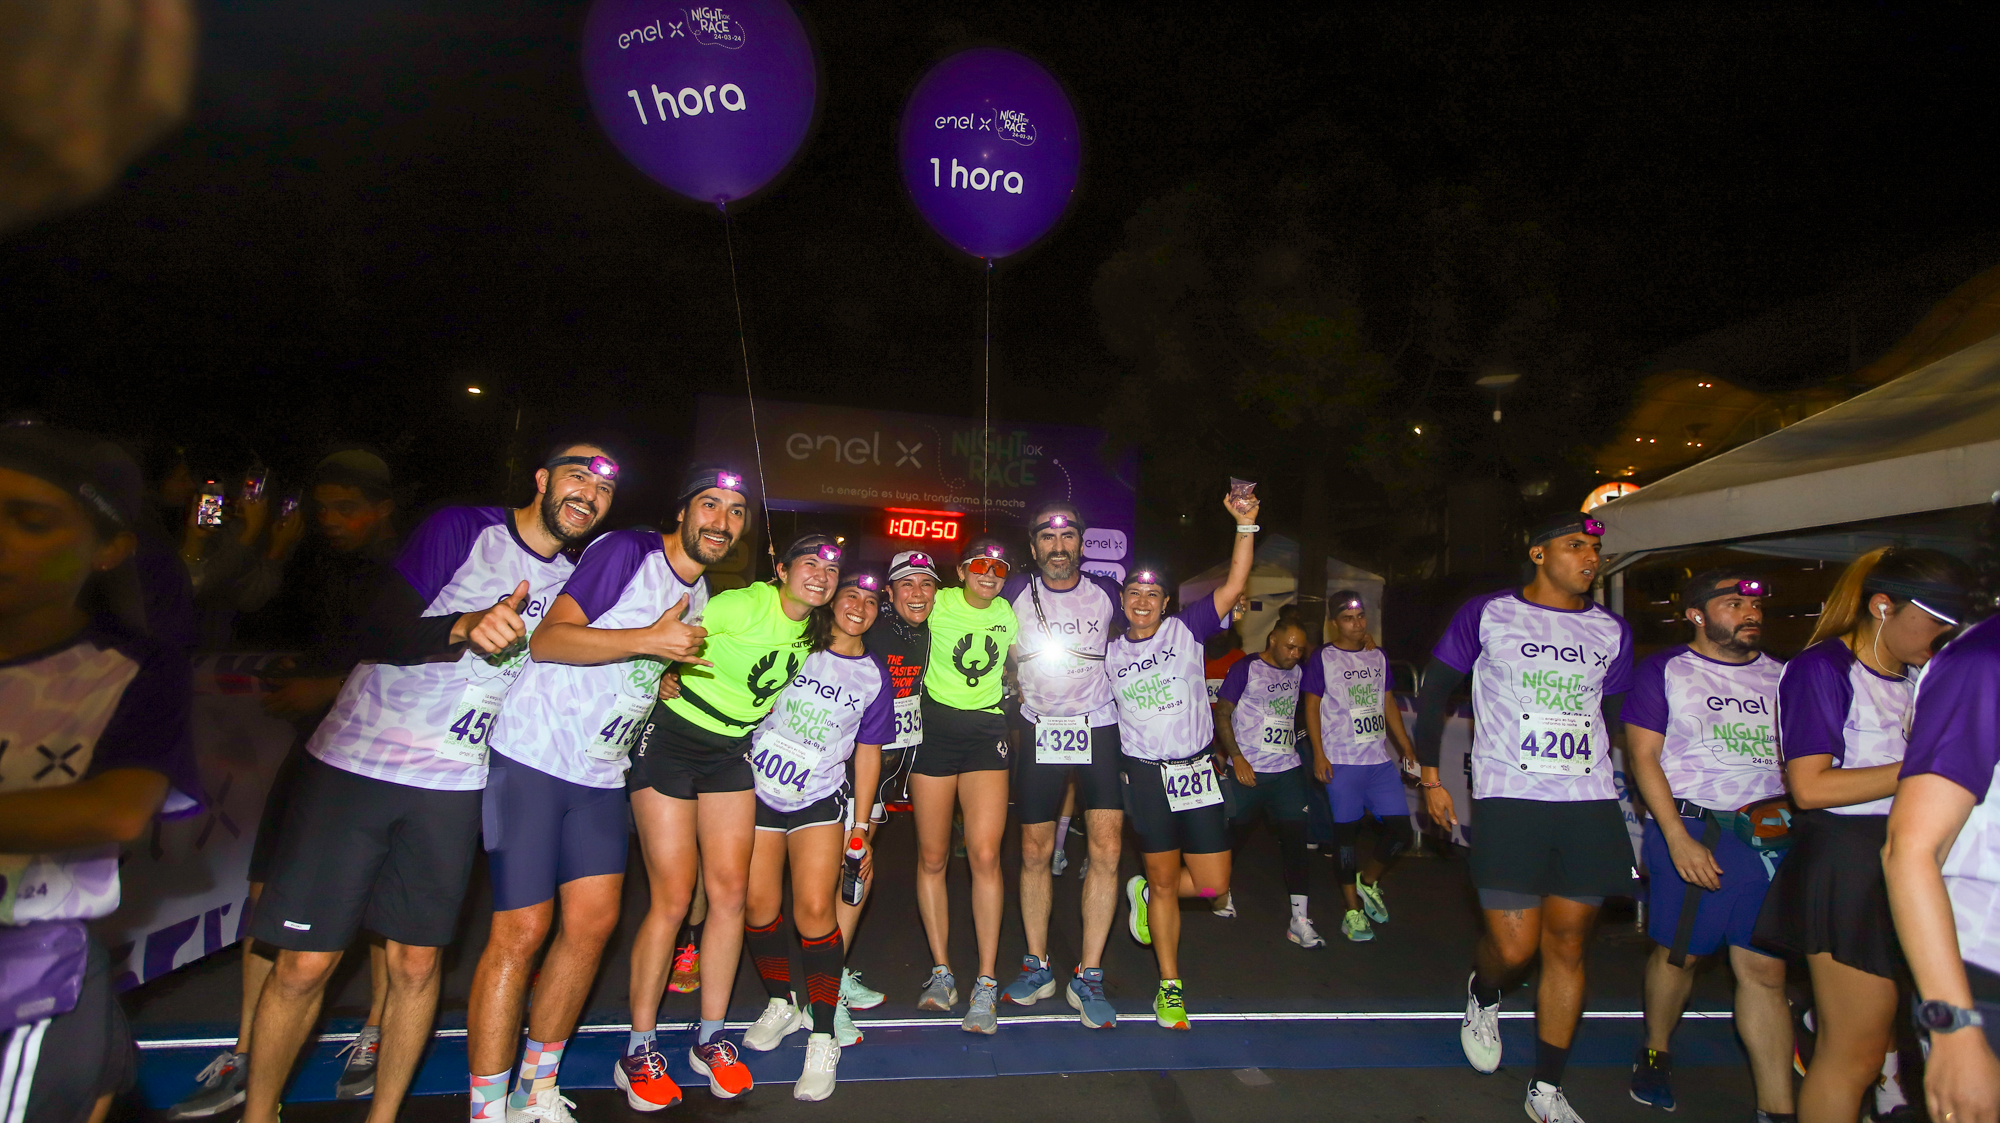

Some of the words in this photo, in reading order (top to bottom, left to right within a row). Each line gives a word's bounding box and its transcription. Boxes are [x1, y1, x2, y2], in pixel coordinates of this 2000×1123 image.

[691, 7, 722, 21] NIGHT
[618, 19, 664, 49] enel
[700, 19, 730, 34] RACE
[627, 89, 648, 125] 1
[651, 83, 747, 121] hora
[935, 113, 974, 130] enel
[1000, 110, 1025, 123] NIGHT
[1004, 120, 1027, 133] RACE
[930, 158, 940, 187] 1
[951, 158, 1024, 195] hora
[785, 431, 881, 466] enel
[951, 426, 1029, 462] NIGHT
[1022, 445, 1044, 456] 10K
[968, 454, 1037, 488] RACE
[821, 484, 834, 494] La
[837, 487, 878, 498] energía
[881, 490, 893, 498] es
[924, 492, 980, 506] transforma
[983, 496, 993, 506] la
[995, 498, 1026, 508] noche
[1084, 539, 1111, 549] enel
[887, 654, 904, 665] THE
[1521, 643, 1586, 664] enel
[1117, 654, 1158, 678] enel
[1343, 667, 1372, 680] enel
[792, 674, 842, 703] enel
[1121, 673, 1161, 702] NIGHT
[1267, 679, 1293, 693] enel
[1348, 684, 1372, 697] NIGHT
[1522, 669, 1584, 694] NIGHT
[896, 688, 912, 698] ON
[1135, 685, 1174, 710] RACE
[1354, 693, 1378, 706] RACE
[1535, 687, 1584, 712] RACE
[786, 698, 832, 725] NIGHT
[824, 719, 836, 728] 10K
[1707, 696, 1768, 715] enel
[788, 714, 830, 743] RACE
[1354, 714, 1385, 734] 3080
[1713, 722, 1770, 740] NIGHT
[1037, 729, 1089, 751] 4329
[1264, 727, 1294, 746] 3270
[1521, 730, 1592, 760] 4204
[1725, 738, 1775, 757] RACE
[753, 749, 811, 792] 4004
[1167, 769, 1212, 798] 4287
